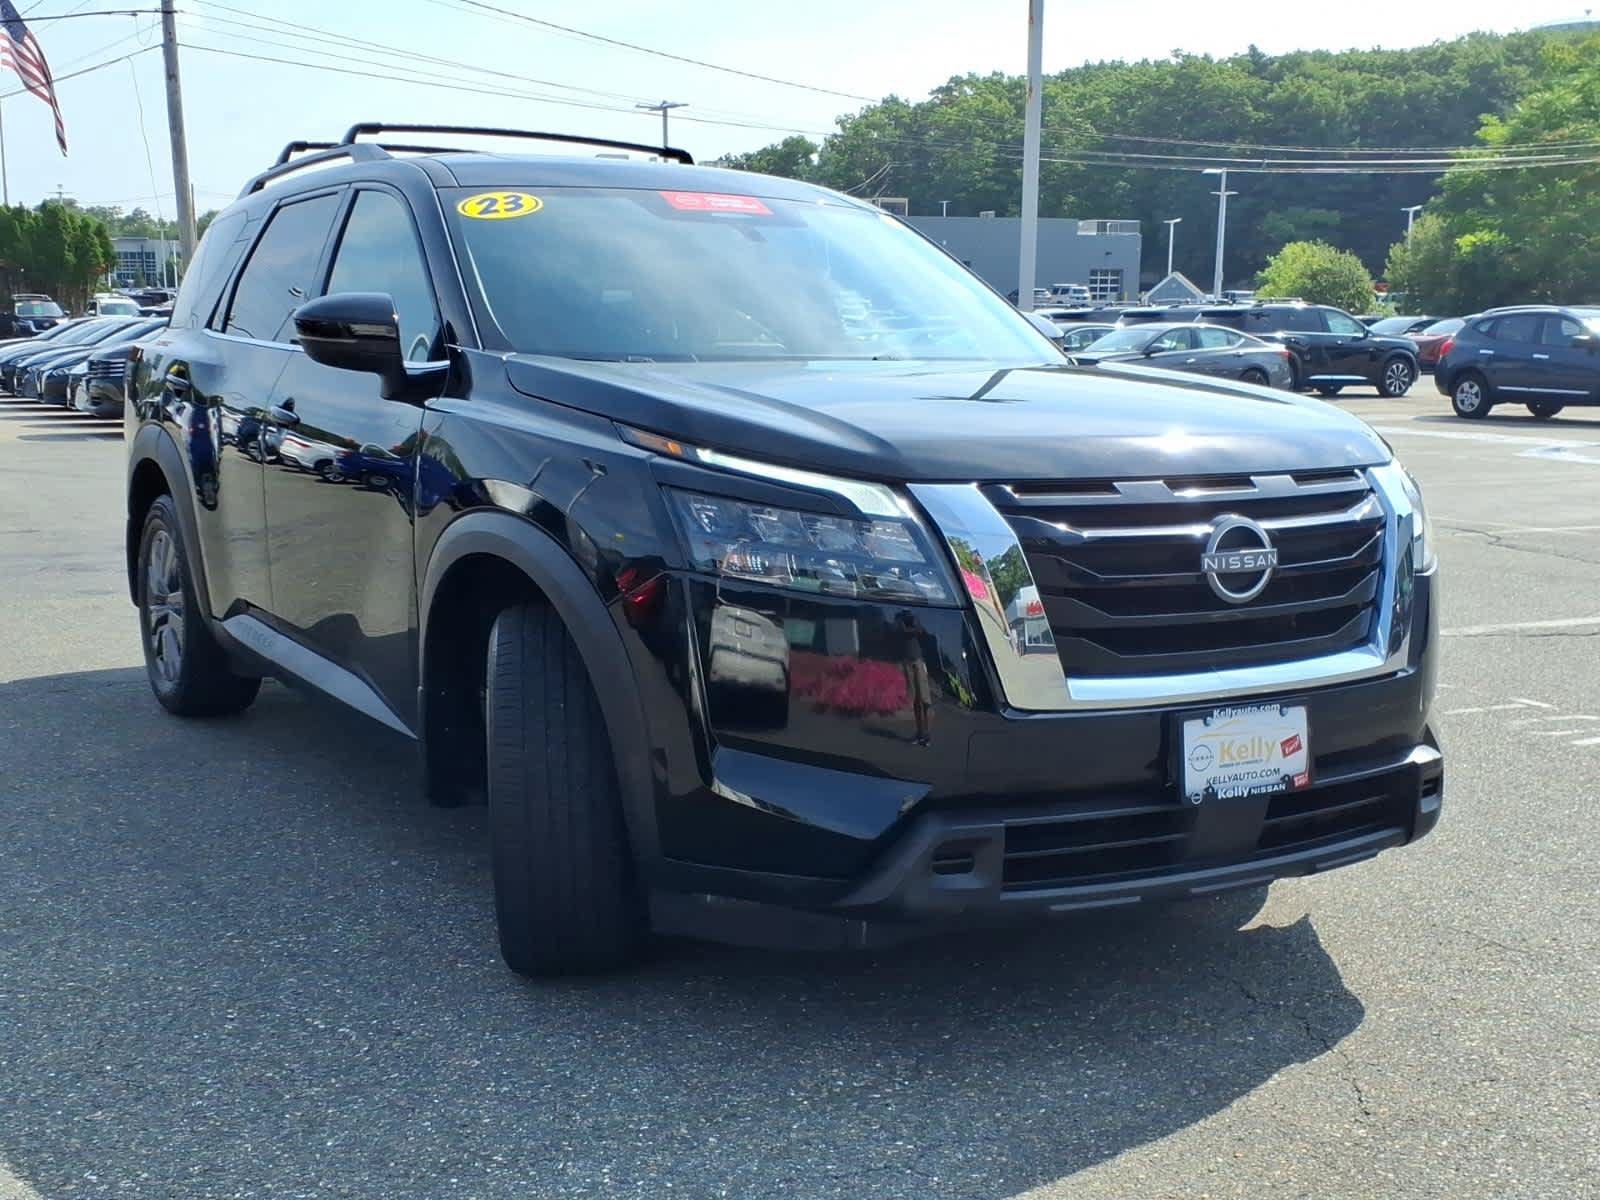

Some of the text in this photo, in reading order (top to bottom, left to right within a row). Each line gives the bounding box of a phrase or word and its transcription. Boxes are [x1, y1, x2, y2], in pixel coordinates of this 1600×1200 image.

[477, 194, 525, 216] 23
[1204, 553, 1277, 570] NISSAN
[1213, 703, 1281, 719] Kellyauto.com
[1219, 736, 1276, 762] Kelly
[1206, 767, 1281, 787] KELLYAUTO.COM
[1217, 783, 1286, 800] Kelly NISSAN
